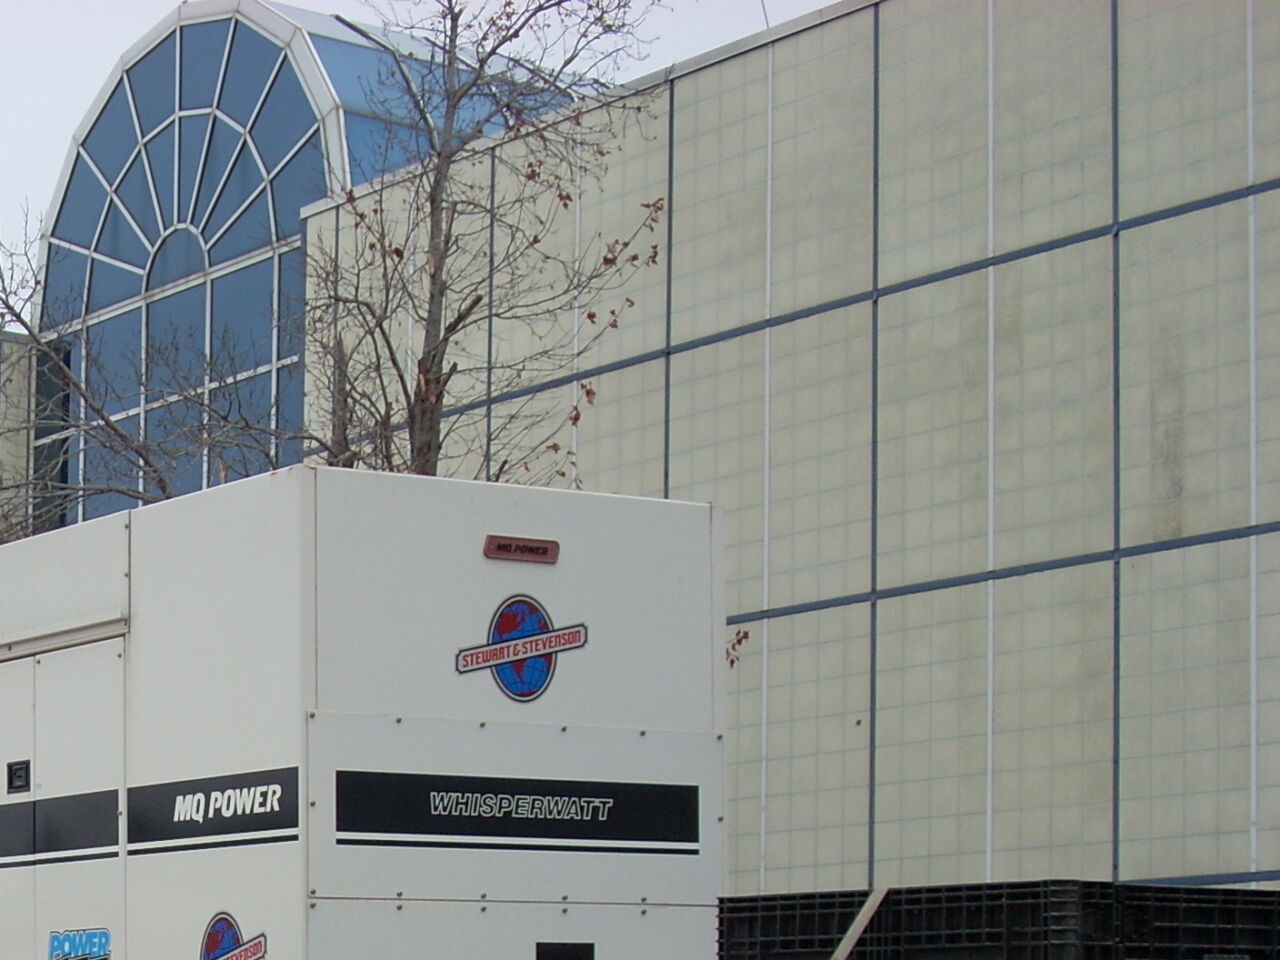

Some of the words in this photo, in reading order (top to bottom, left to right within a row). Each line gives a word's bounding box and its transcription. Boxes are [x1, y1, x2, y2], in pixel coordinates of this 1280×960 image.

[462, 645, 511, 668] STEWART
[512, 643, 521, 657] &
[522, 630, 581, 655] STEVENSON
[173, 792, 206, 824] MQ
[207, 784, 282, 819] POWER
[429, 791, 613, 821] WHISPERWATT
[48, 929, 111, 960] POWER
